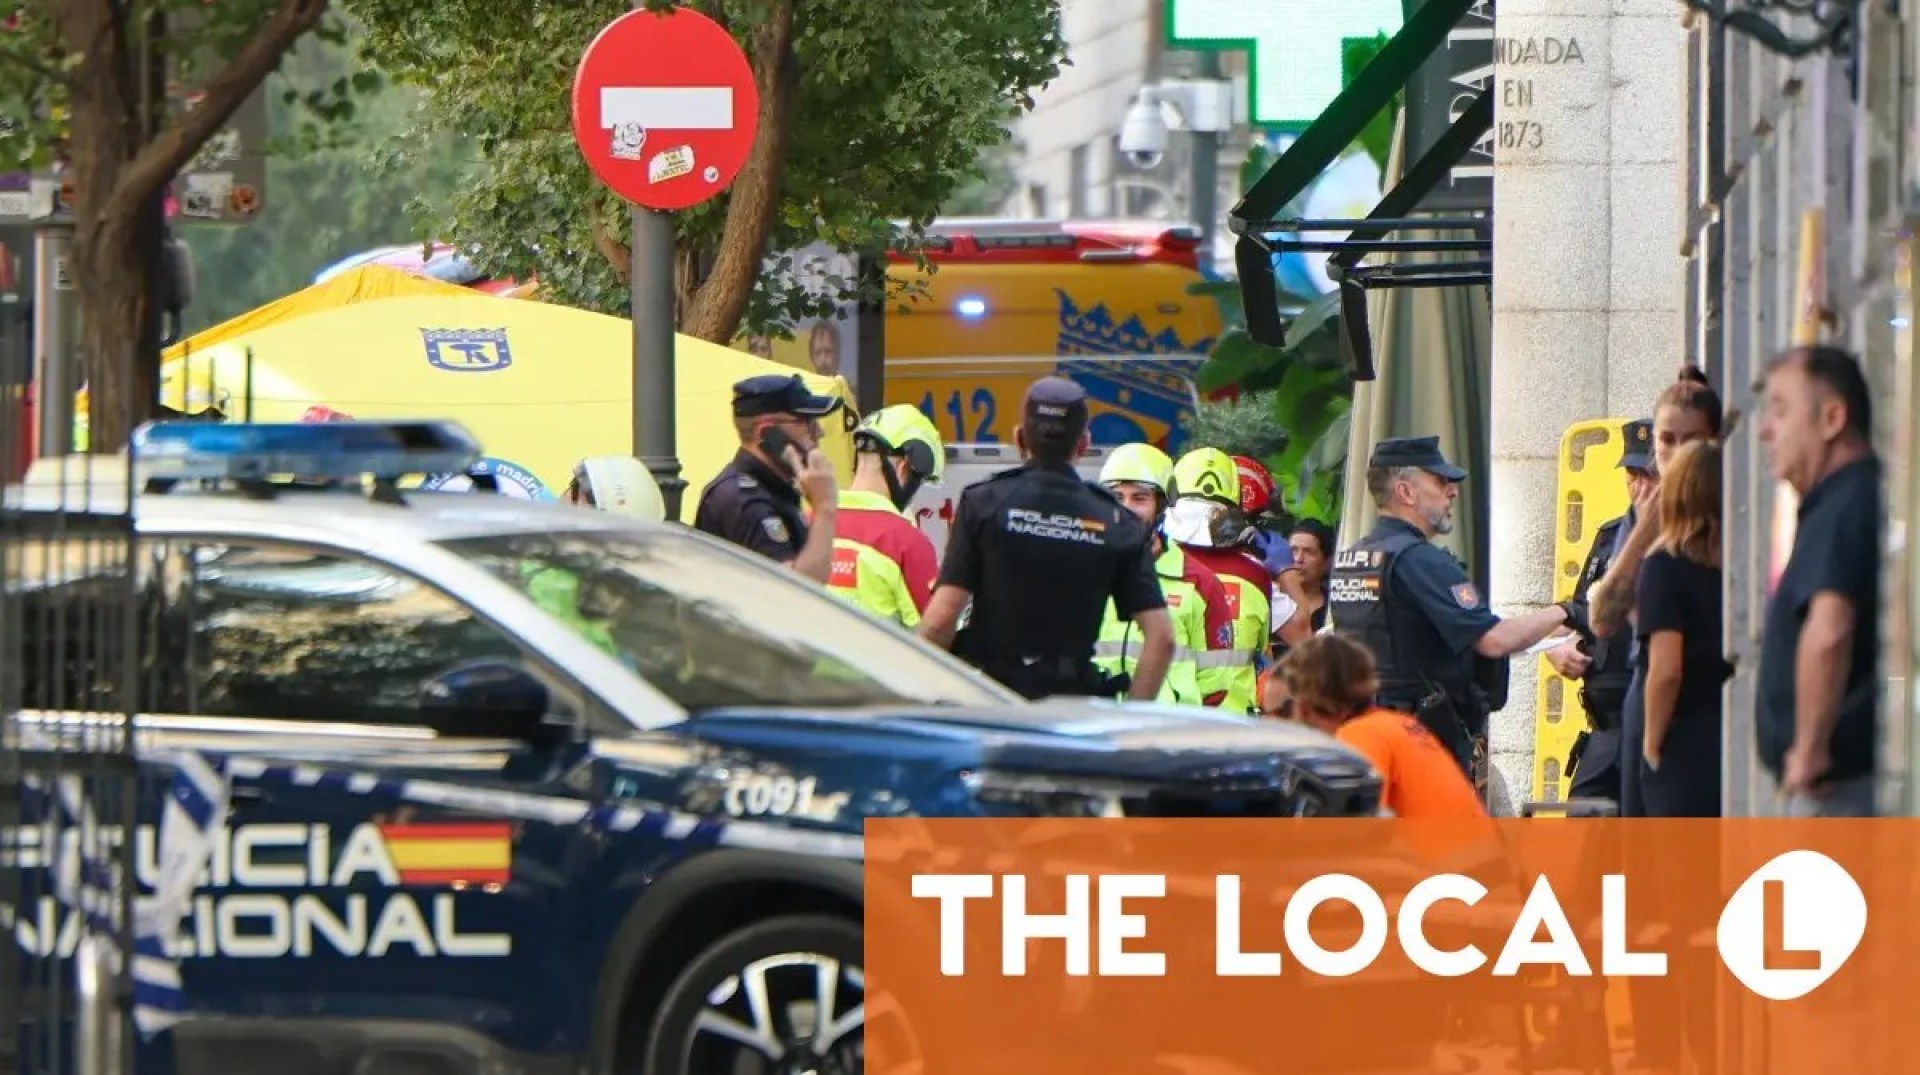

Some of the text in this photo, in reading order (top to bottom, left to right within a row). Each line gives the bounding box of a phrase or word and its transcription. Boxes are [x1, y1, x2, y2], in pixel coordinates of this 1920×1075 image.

[1503, 79, 1533, 108] EN
[1498, 120, 1544, 150] 1873
[919, 388, 999, 443] 112
[1007, 521, 1105, 545] NACIONAL
[1008, 508, 1085, 529] POLICIA
